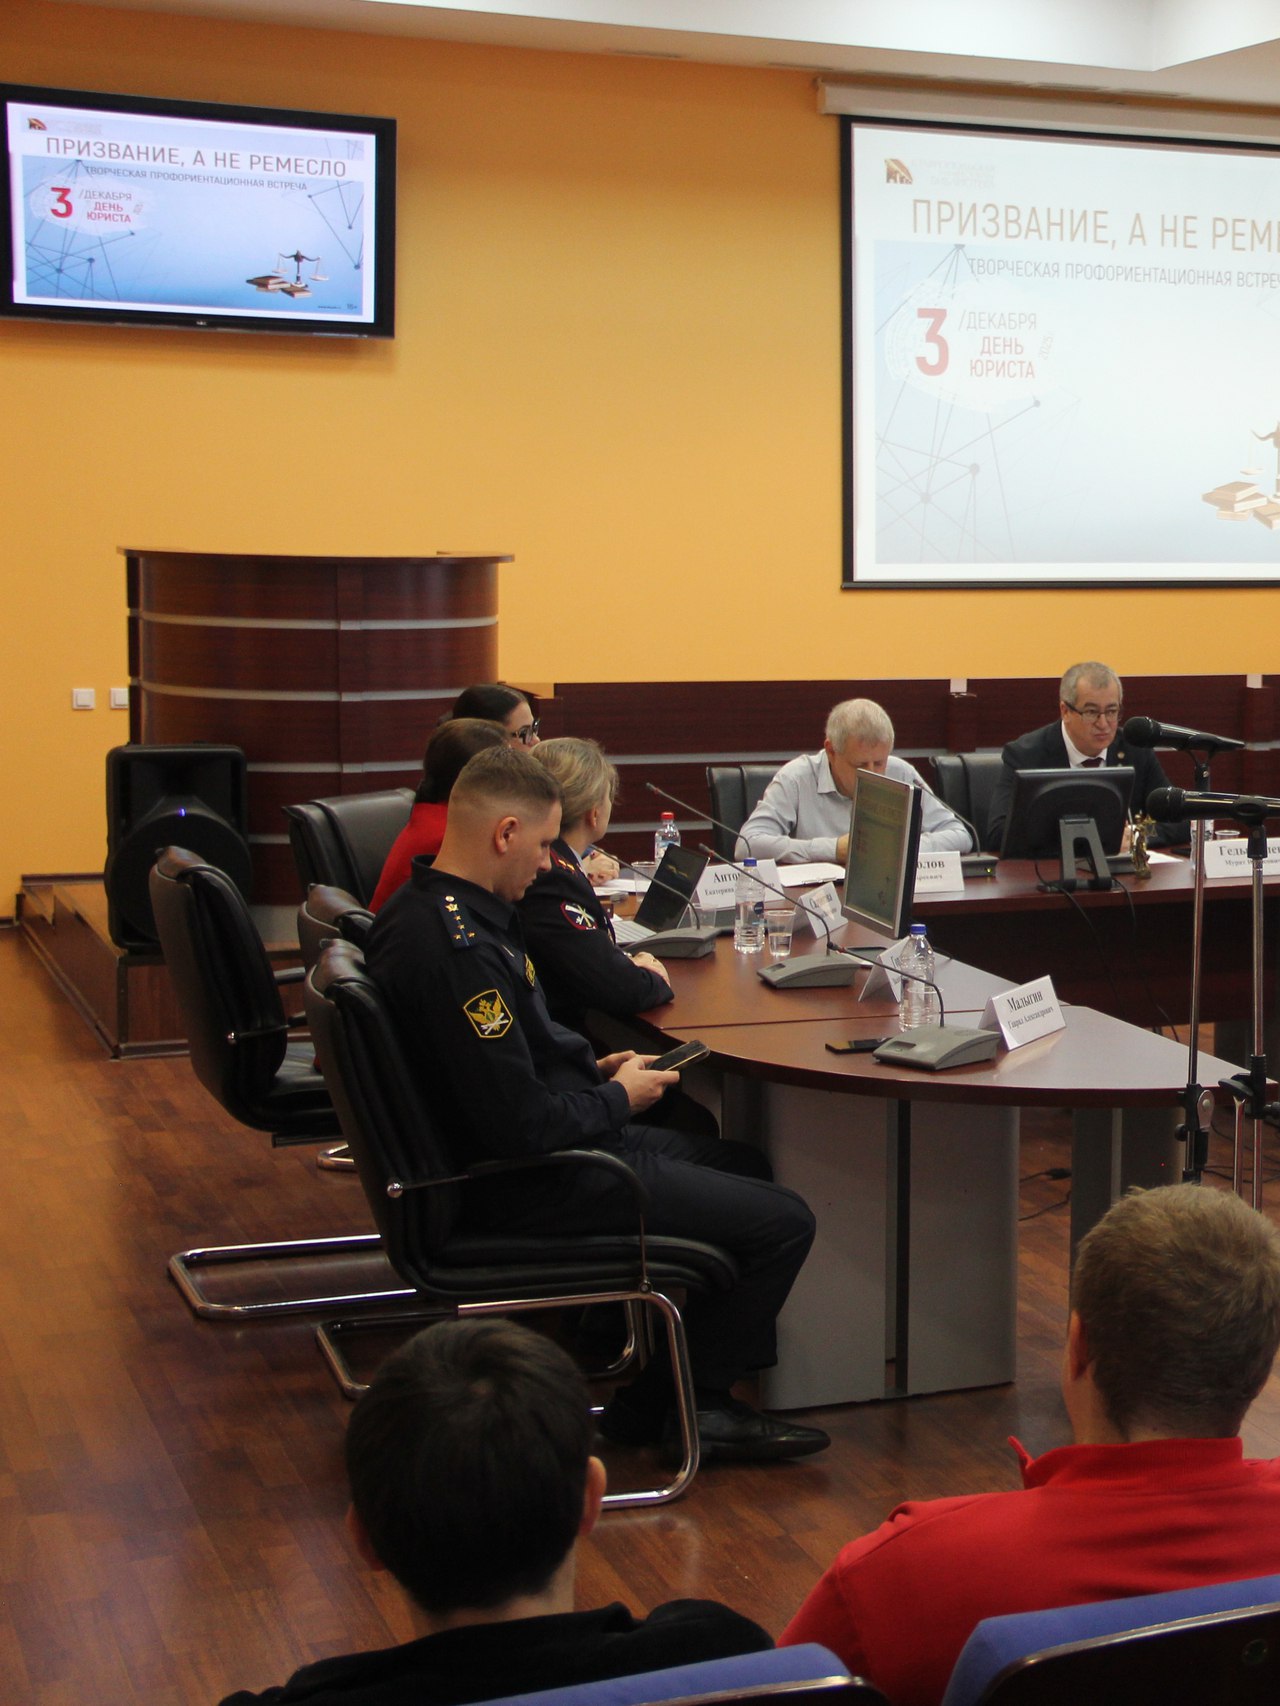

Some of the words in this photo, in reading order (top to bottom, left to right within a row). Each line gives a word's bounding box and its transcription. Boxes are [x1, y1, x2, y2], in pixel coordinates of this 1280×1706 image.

[46, 137, 185, 167] ПРИЗВАНИЕ,
[191, 150, 206, 166] А
[214, 152, 241, 169] НЕ
[249, 154, 346, 177] РЕМЕСЛО
[86, 166, 147, 178] ТВОРЧЕСКАЯ
[150, 171, 265, 188] ПРОФОРИЕНТАЦИОННАЯ
[267, 180, 308, 191] ВСТРЕЧА
[50, 187, 73, 219] 3
[94, 201, 124, 213] ДЕНЬ
[87, 211, 132, 223] ЮРИСТА
[912, 199, 1116, 250] ПРИЗВАНИЕ,
[1128, 212, 1147, 247] А
[1160, 214, 1198, 249] НЕ
[968, 257, 1060, 279] ТВОРЧЕСКАЯ
[1065, 263, 1232, 287] ПРОФОРИЕНТАЦИОННАЯ
[915, 307, 949, 376] 3
[980, 336, 1024, 356] ДЕНЬ
[970, 359, 1035, 379] ЮРИСТА
[1007, 991, 1044, 1013] Малыгин
